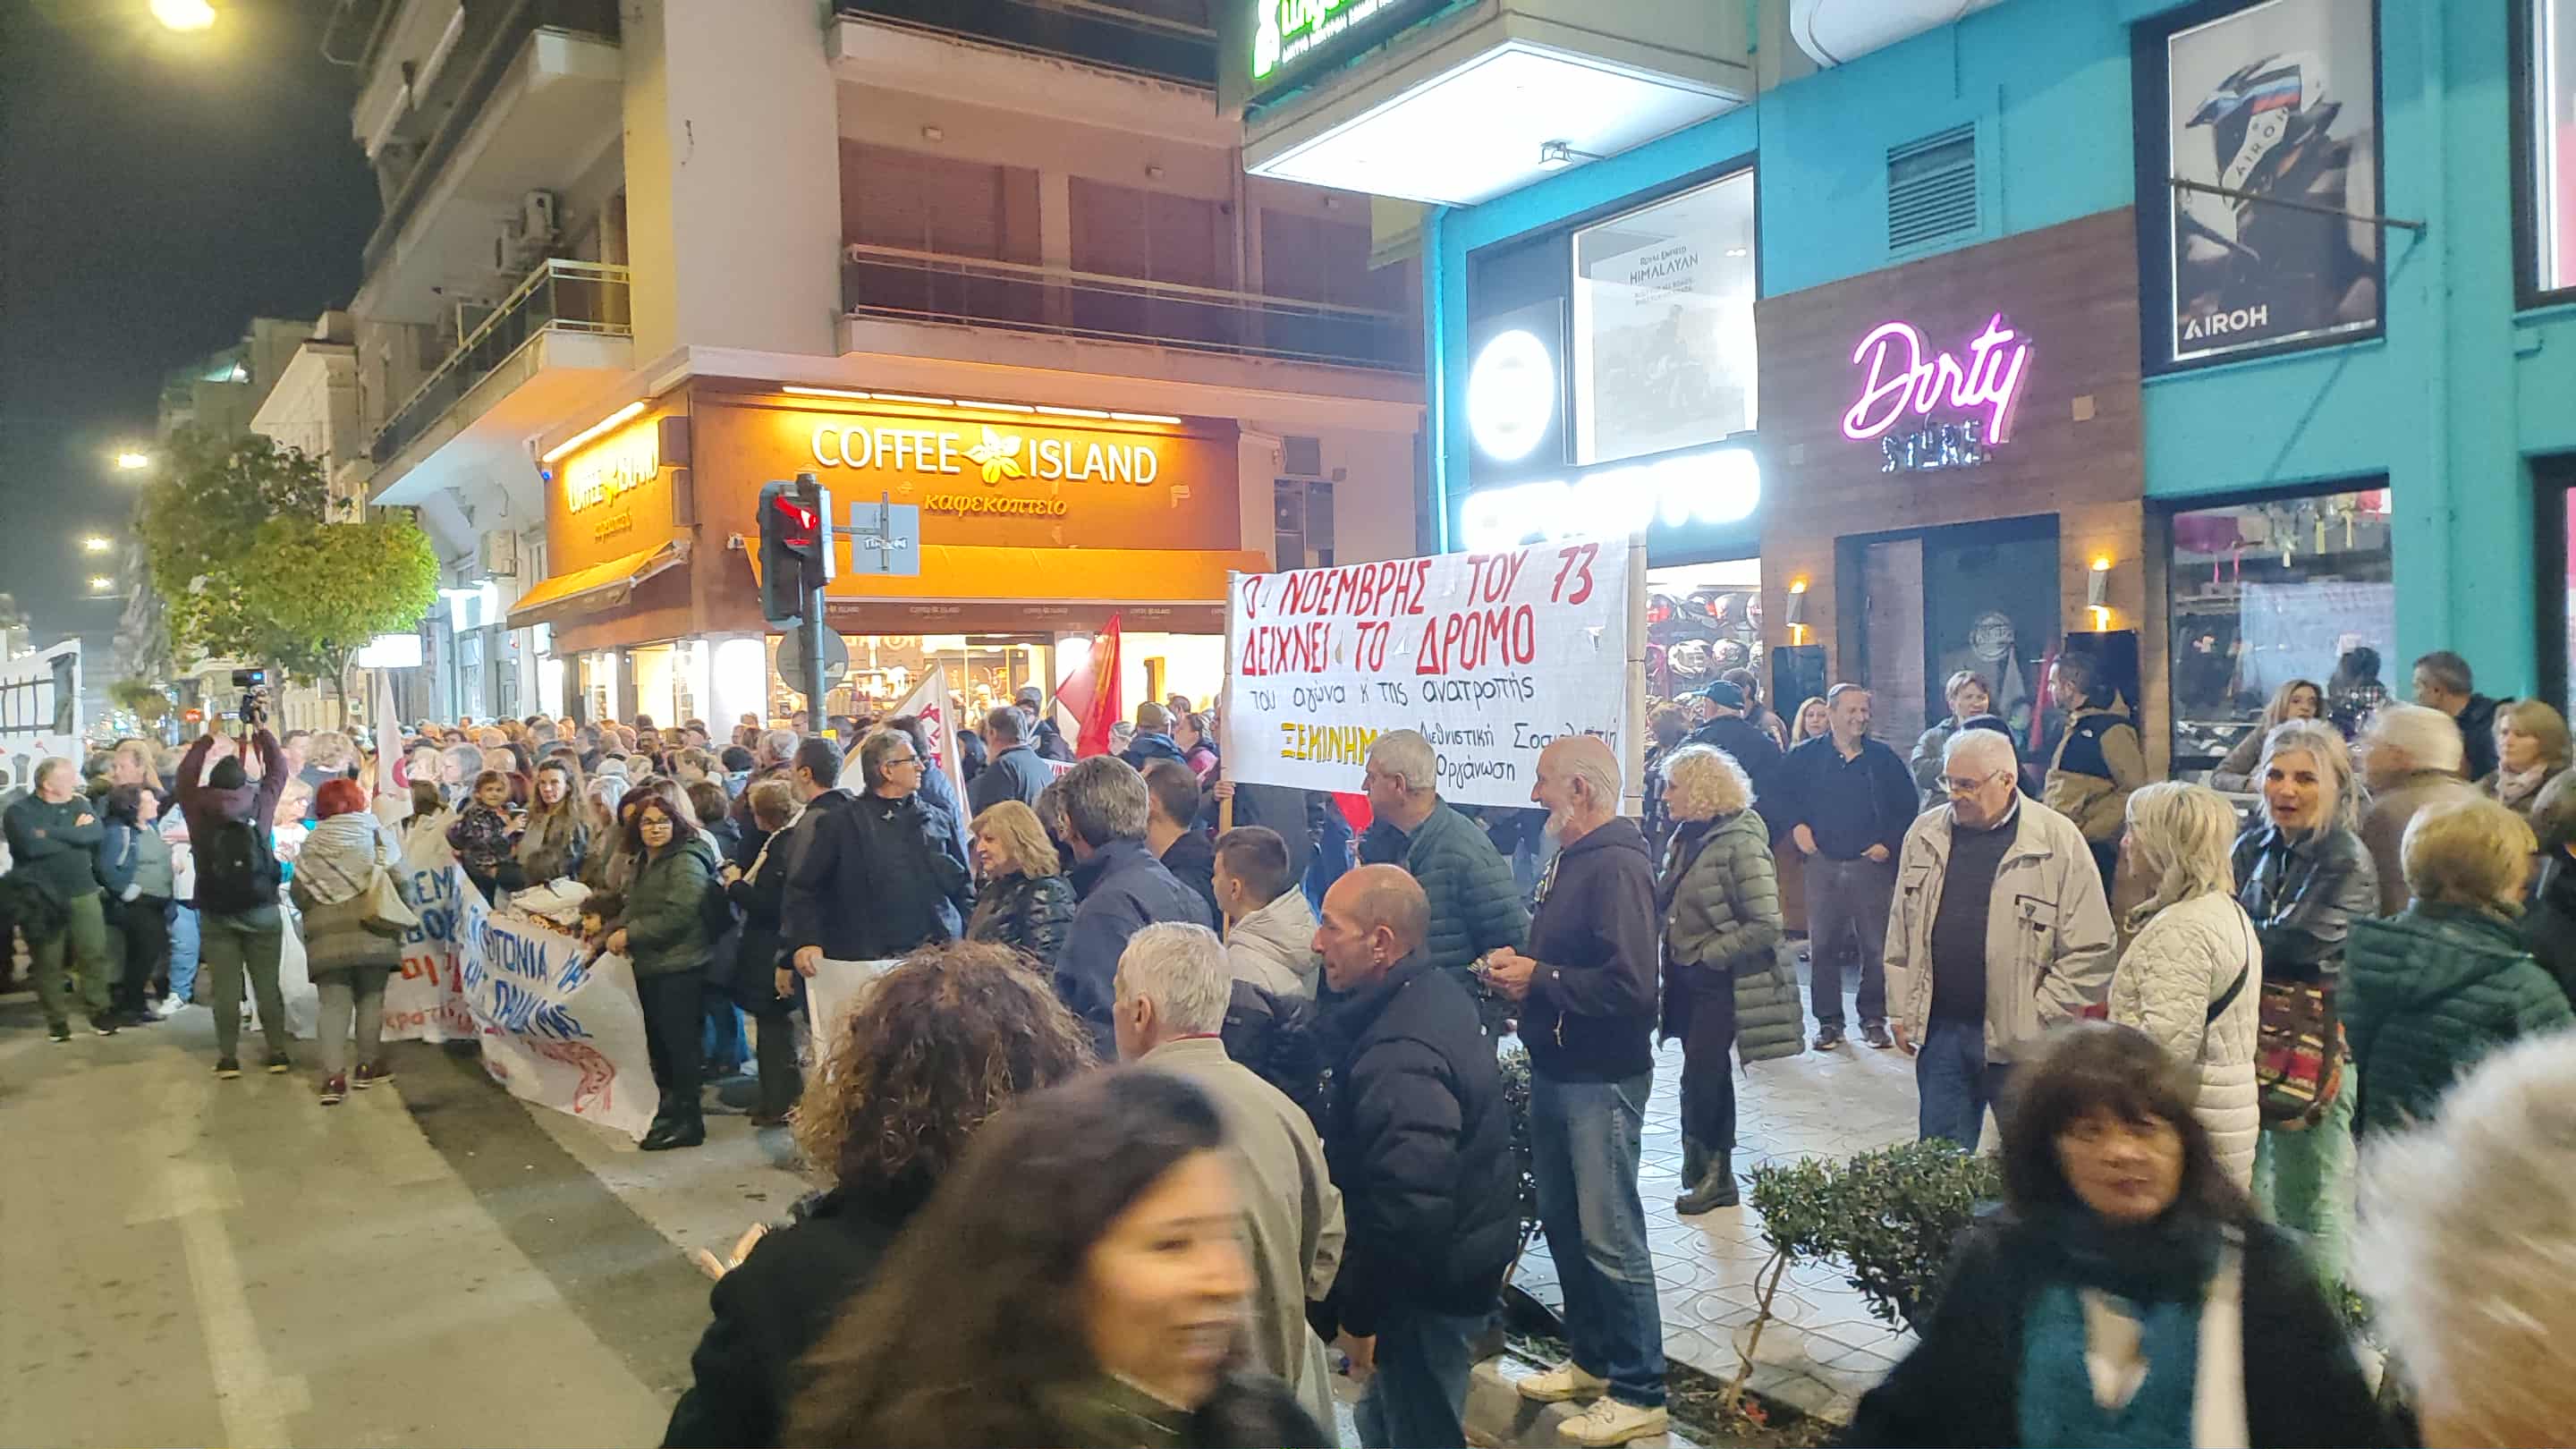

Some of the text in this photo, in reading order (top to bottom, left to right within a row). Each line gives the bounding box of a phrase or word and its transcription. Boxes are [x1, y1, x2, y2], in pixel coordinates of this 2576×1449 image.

[1630, 250, 1699, 285] HIMALAYAN
[2182, 303, 2268, 341] AIROH
[1843, 312, 2027, 445] Dirty
[811, 424, 1158, 485] COFFEE ISLAND
[924, 490, 1068, 518] καφεκοπτείο
[1278, 559, 1432, 617] ΝΟΕΜΒΡΗΣ
[1466, 548, 1530, 607] ΤΟΥ
[1551, 542, 1599, 606] 73
[1242, 604, 1535, 676] ΔΕΙΧΝΕΙ ΤΟ ΔΡΟΜΟ
[1292, 679, 1346, 713] αγώνα
[1377, 682, 1409, 707] της
[1422, 671, 1535, 712] ανατροπής
[1281, 722, 1388, 767] ΞΕΚΙΝΗΜ
[1436, 754, 1516, 790] Οργάνωση
